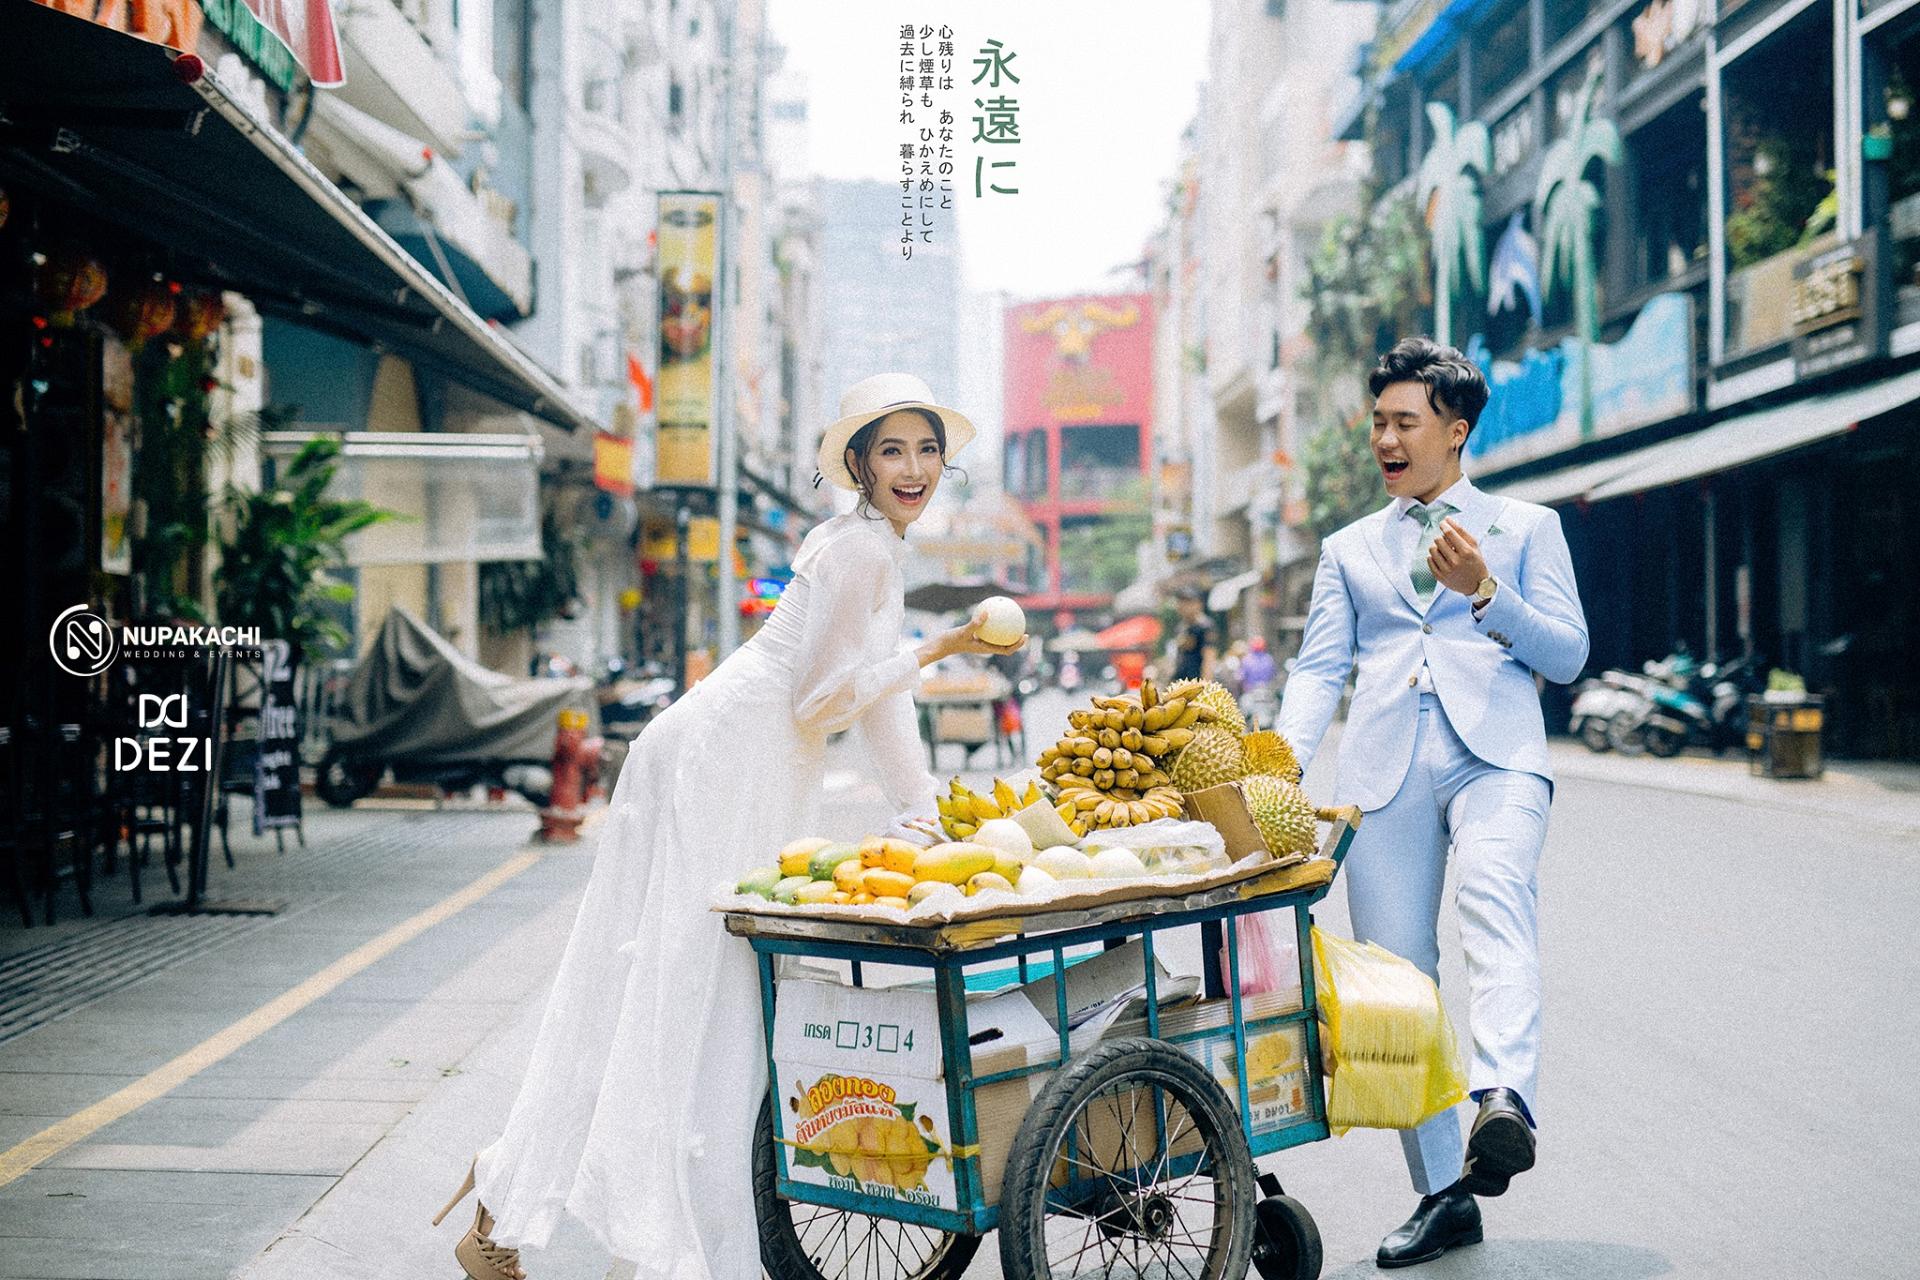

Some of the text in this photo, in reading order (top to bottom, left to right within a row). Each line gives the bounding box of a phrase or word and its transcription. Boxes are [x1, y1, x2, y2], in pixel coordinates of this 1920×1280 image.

[804, 1023, 914, 1052] เกรด 3 4
[807, 1076, 896, 1113] ลองกอง
[907, 1187, 940, 1207] อร่อย
